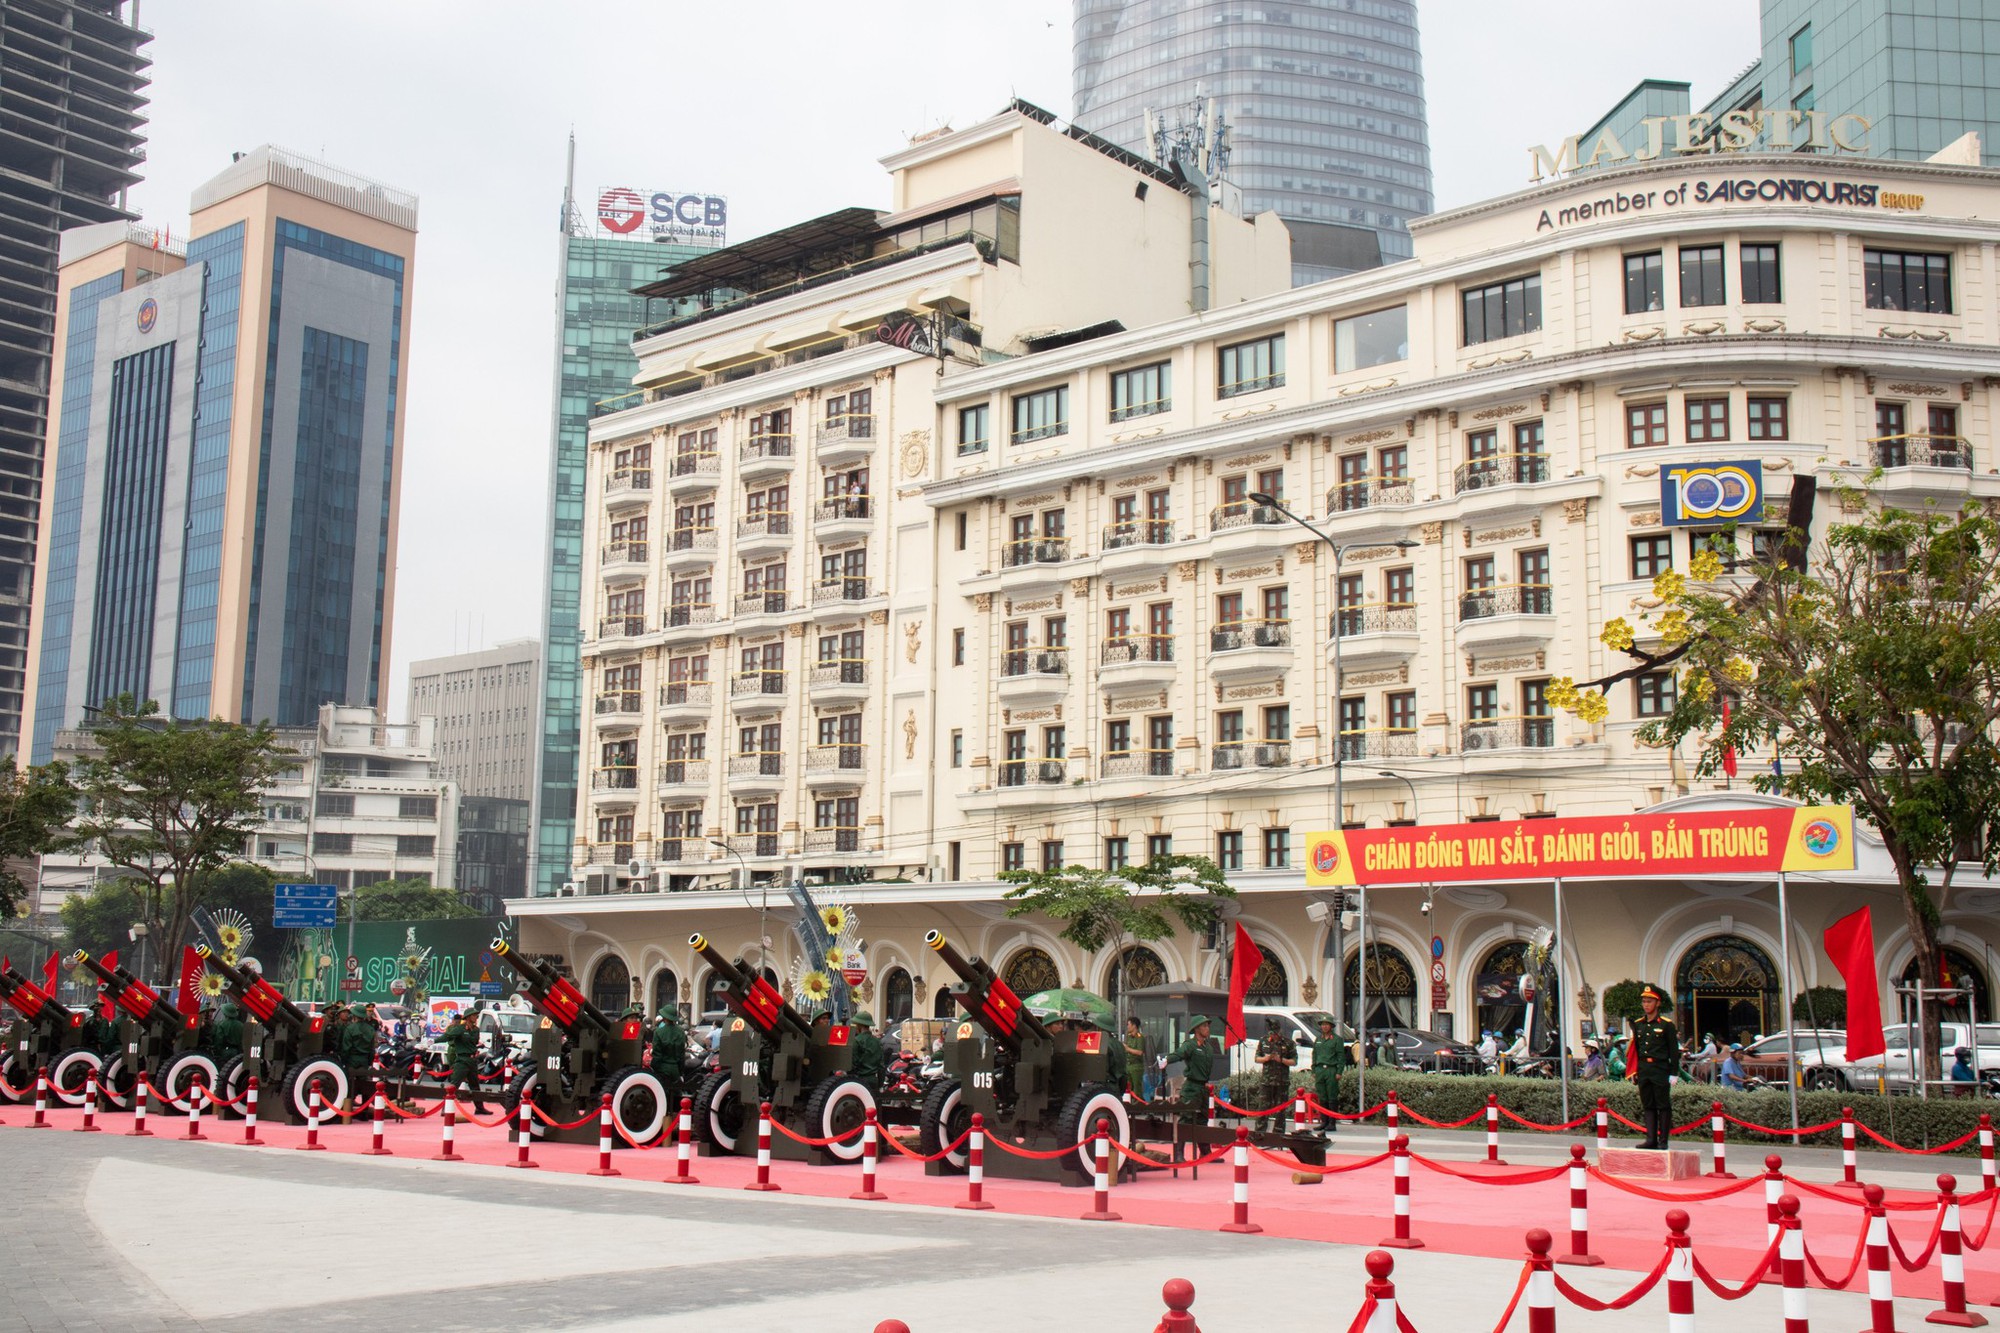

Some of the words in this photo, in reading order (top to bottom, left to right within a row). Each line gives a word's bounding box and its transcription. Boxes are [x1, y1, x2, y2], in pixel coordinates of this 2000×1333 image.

[1527, 110, 1872, 182] MAJESTIC
[650, 193, 727, 226] SCB
[1536, 210, 1553, 232] A
[1559, 191, 1656, 226] member
[1663, 182, 1687, 206] of
[1694, 179, 1879, 207] SAIGONTOURIST
[1880, 191, 1924, 210] GROUP
[1667, 465, 1757, 520] 100
[1365, 837, 1411, 871] CHÂN
[1415, 831, 1463, 869] ĐỒNG
[1467, 838, 1496, 866] VAI
[1501, 826, 1538, 867] SẮT,
[1543, 828, 1595, 863] ĐÁNH
[1600, 821, 1646, 864] GIỎI,
[1651, 818, 1694, 860] BẮN
[1698, 821, 1769, 858] TRÚNG
[250, 1046, 261, 1058] 012
[547, 1055, 561, 1070] 013
[742, 1060, 759, 1076] 014
[973, 1071, 993, 1089] 015
